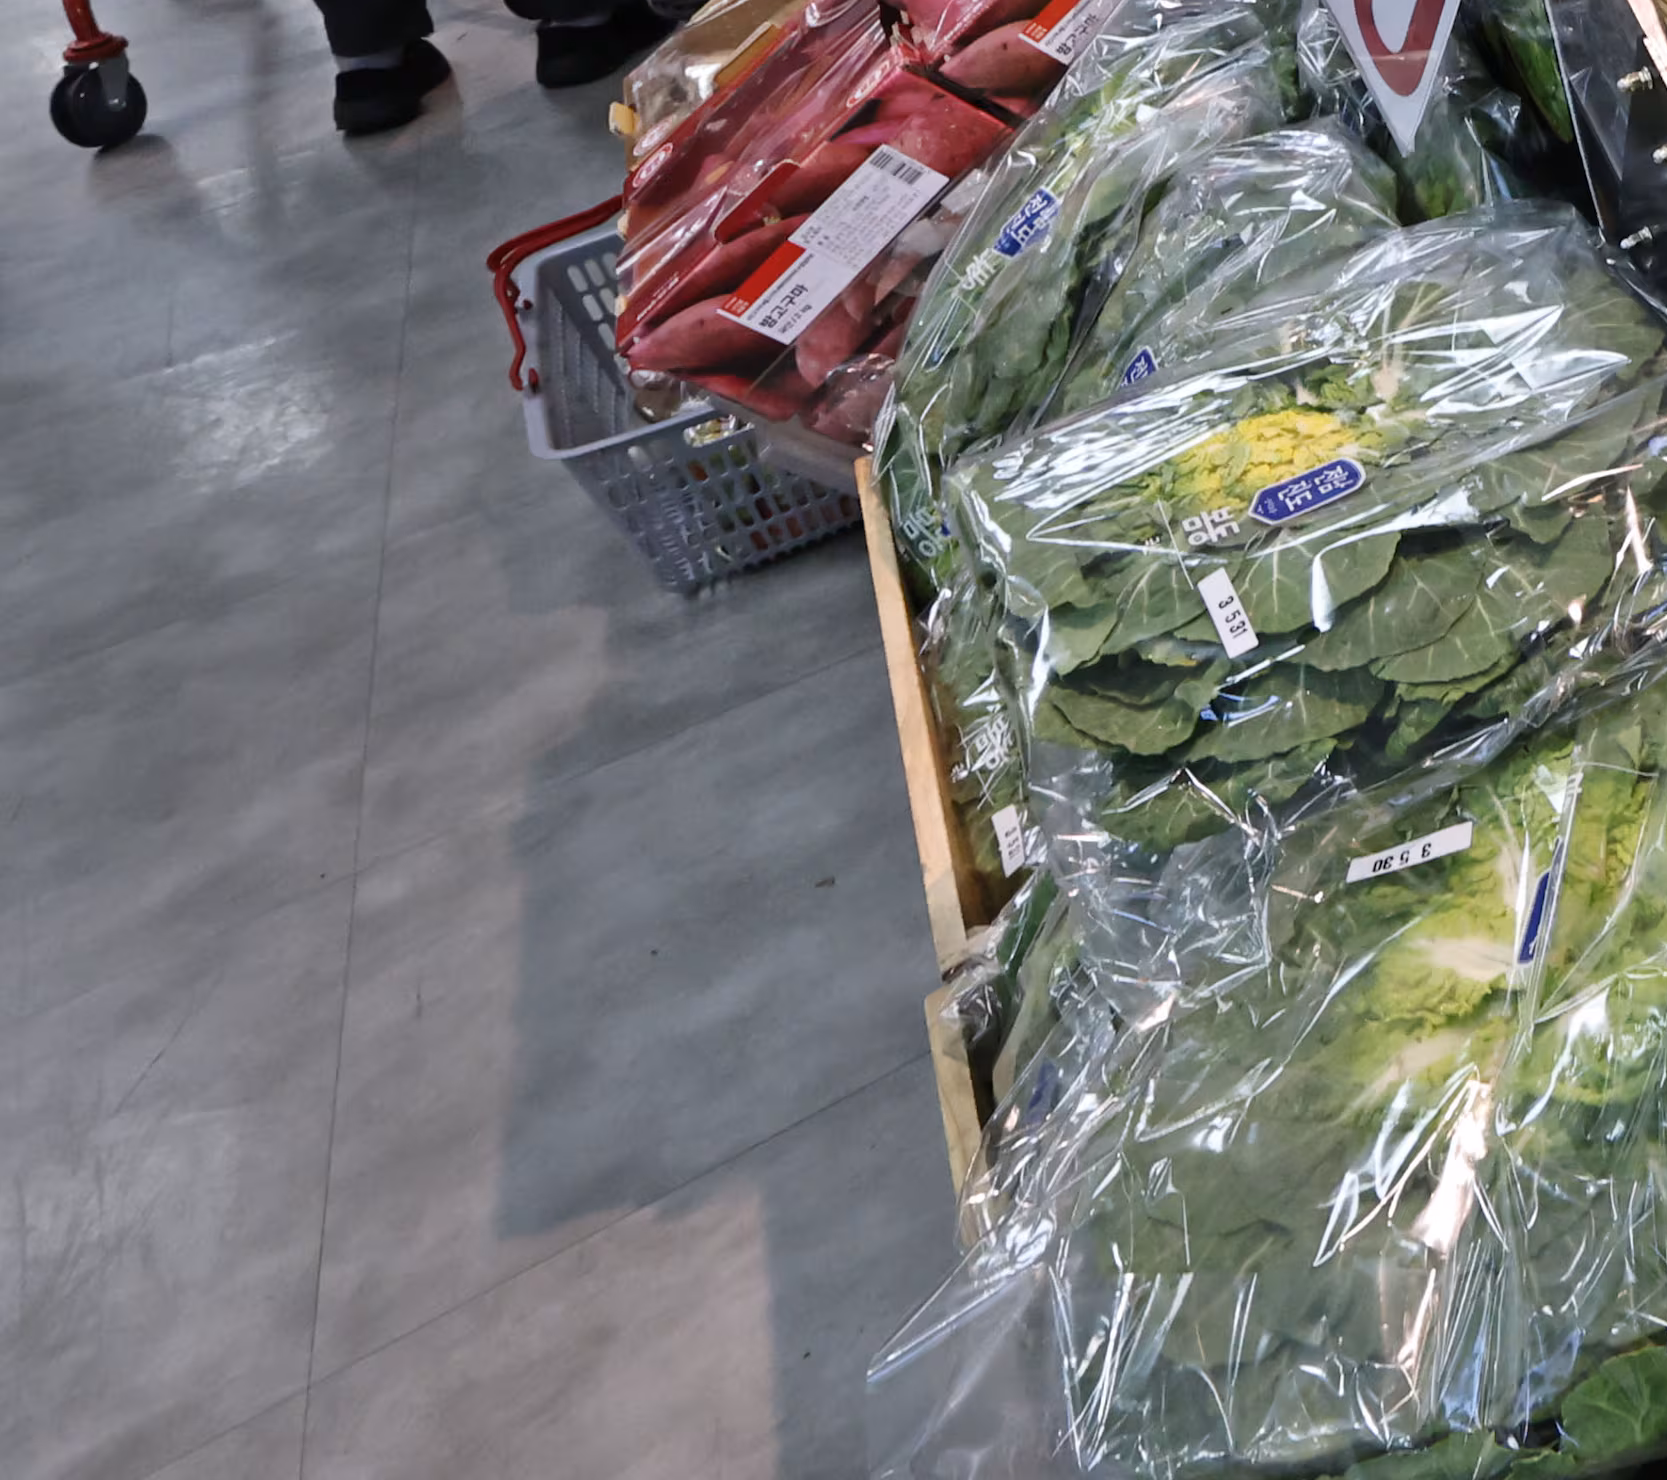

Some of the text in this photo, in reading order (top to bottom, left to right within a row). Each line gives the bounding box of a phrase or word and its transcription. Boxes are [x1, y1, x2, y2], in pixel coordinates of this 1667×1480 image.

[762, 286, 806, 329] 밤고구마
[1277, 479, 1313, 512] 진도
[1313, 464, 1354, 494] 전남
[1181, 506, 1241, 546] 봄동
[1218, 595, 1249, 640] 3 5 31
[1371, 842, 1432, 873] 3 5 30
